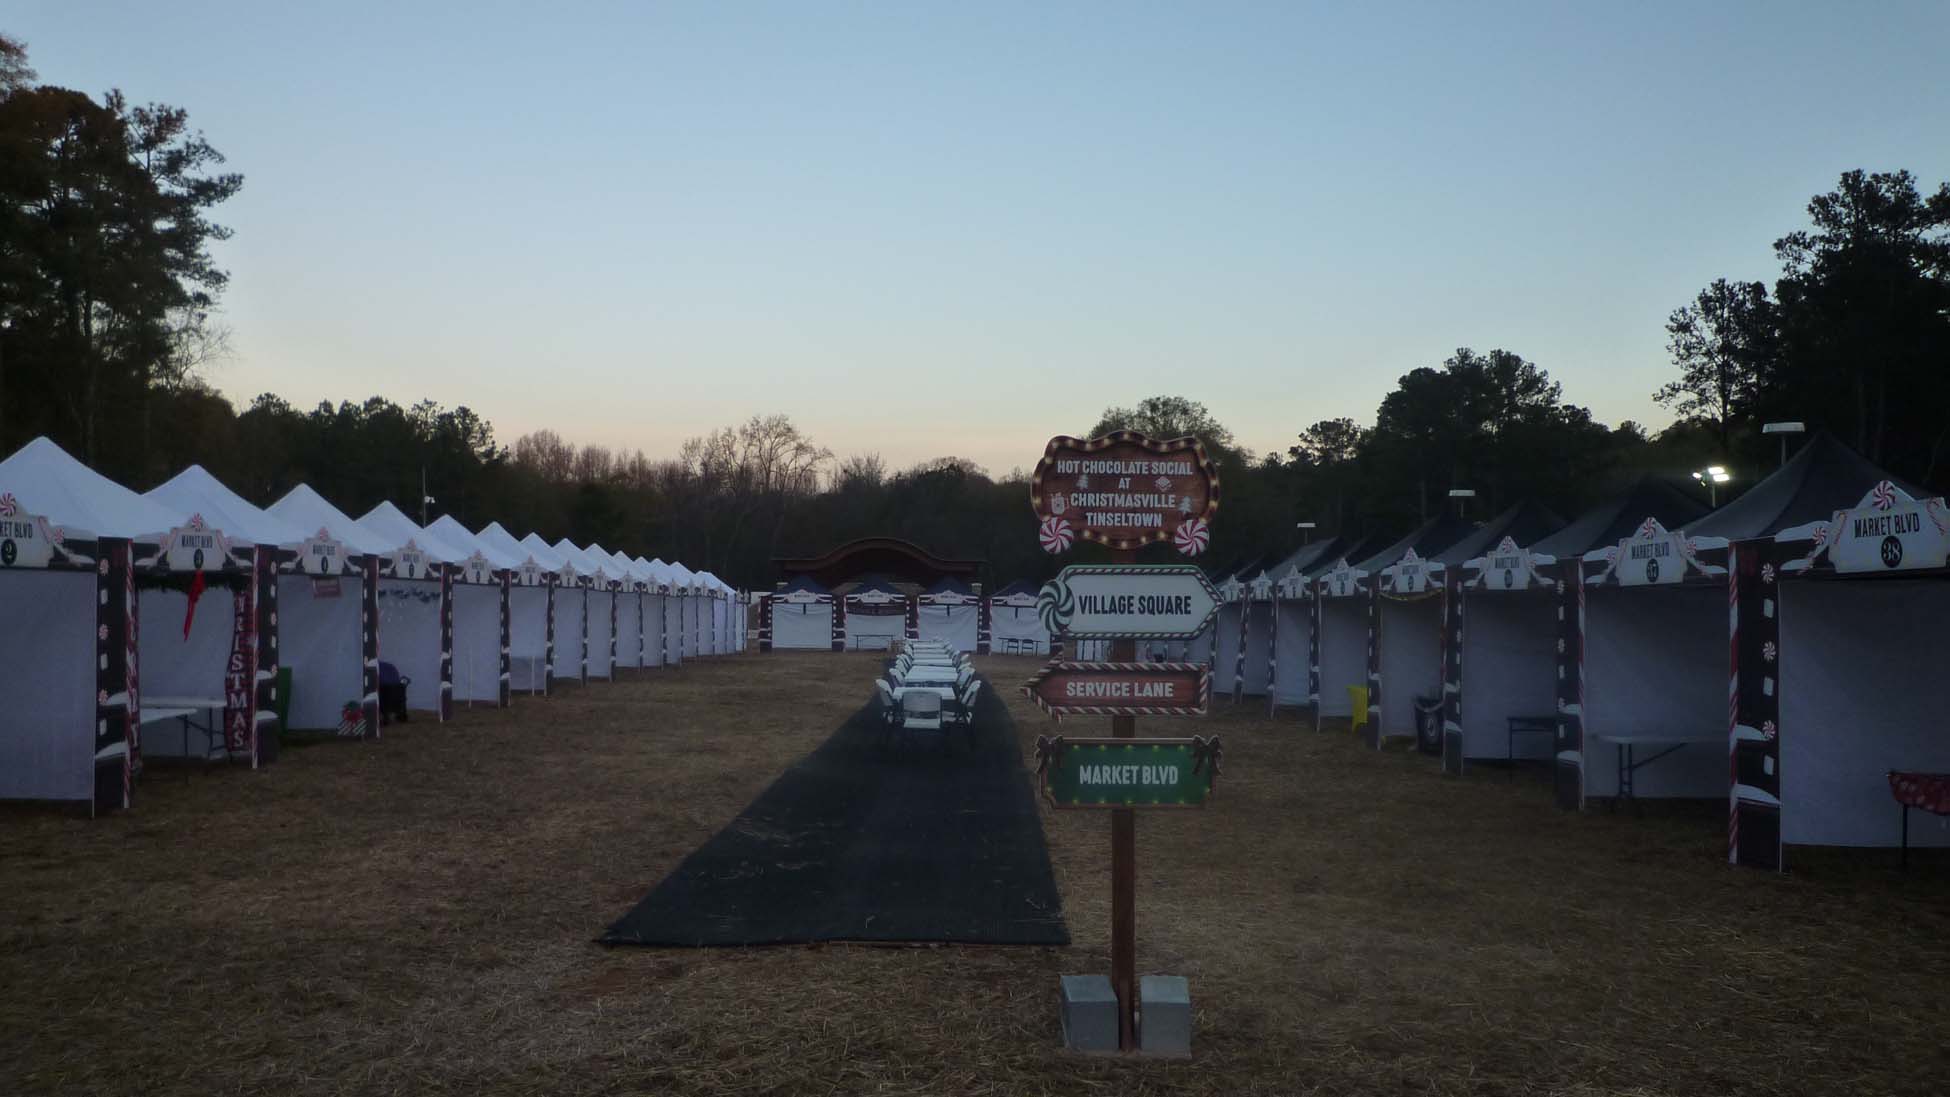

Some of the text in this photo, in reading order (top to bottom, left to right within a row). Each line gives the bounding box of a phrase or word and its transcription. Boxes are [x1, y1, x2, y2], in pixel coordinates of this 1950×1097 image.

[1057, 460, 1193, 475] HOT CHOCOLATE SOCIAL
[1118, 477, 1131, 490] AT
[1070, 493, 1176, 508] CHRISTMASVILLE
[1086, 512, 1162, 527] TINSELTOWN
[1854, 512, 1920, 538] MARKET BLVD
[15, 521, 33, 539] BLVD
[1632, 543, 1653, 560] MARKET
[1078, 595, 1192, 616] VILLAGE SQUARE
[1066, 681, 1174, 698] SERVICE LANE
[1079, 764, 1179, 785] MARKET BLVD
